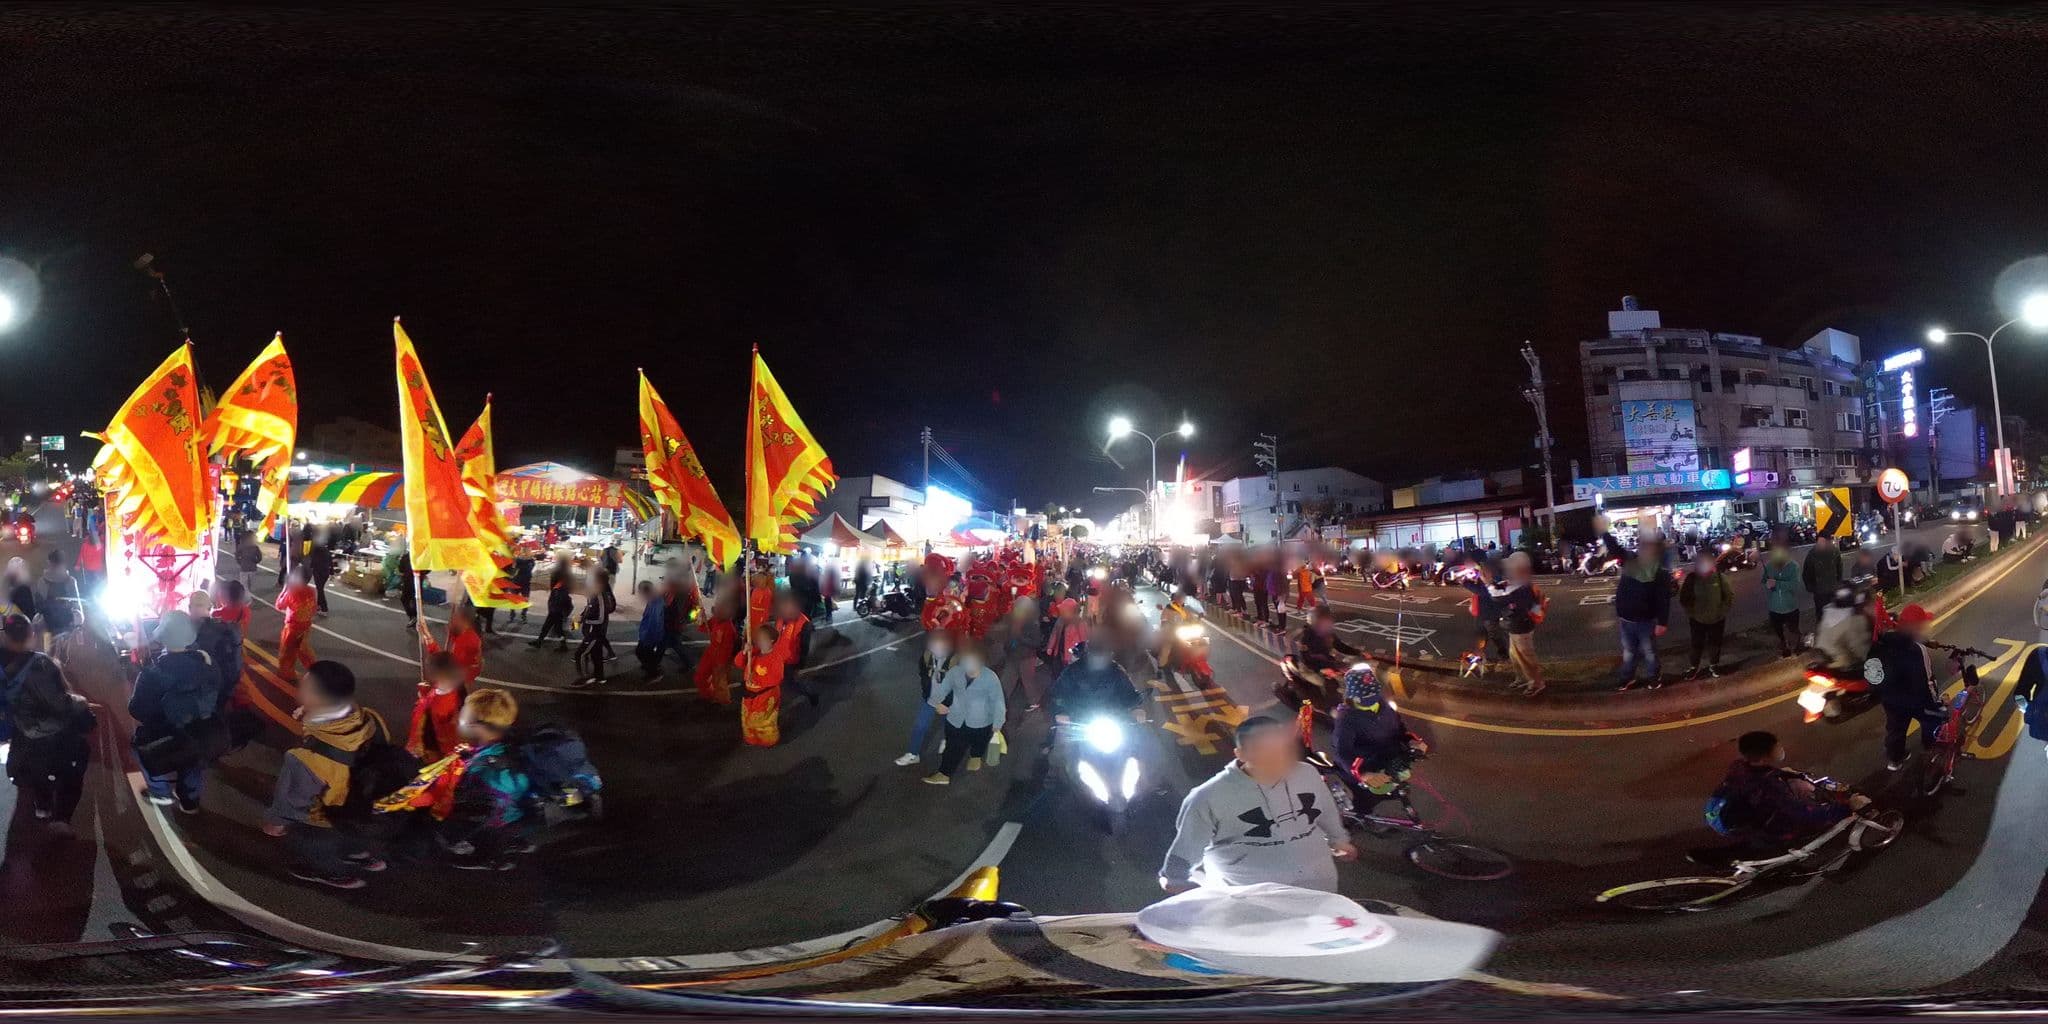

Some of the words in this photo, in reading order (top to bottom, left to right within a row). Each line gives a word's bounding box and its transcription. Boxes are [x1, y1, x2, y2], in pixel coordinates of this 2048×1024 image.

[1601, 471, 1700, 490] 大菩提電動車
